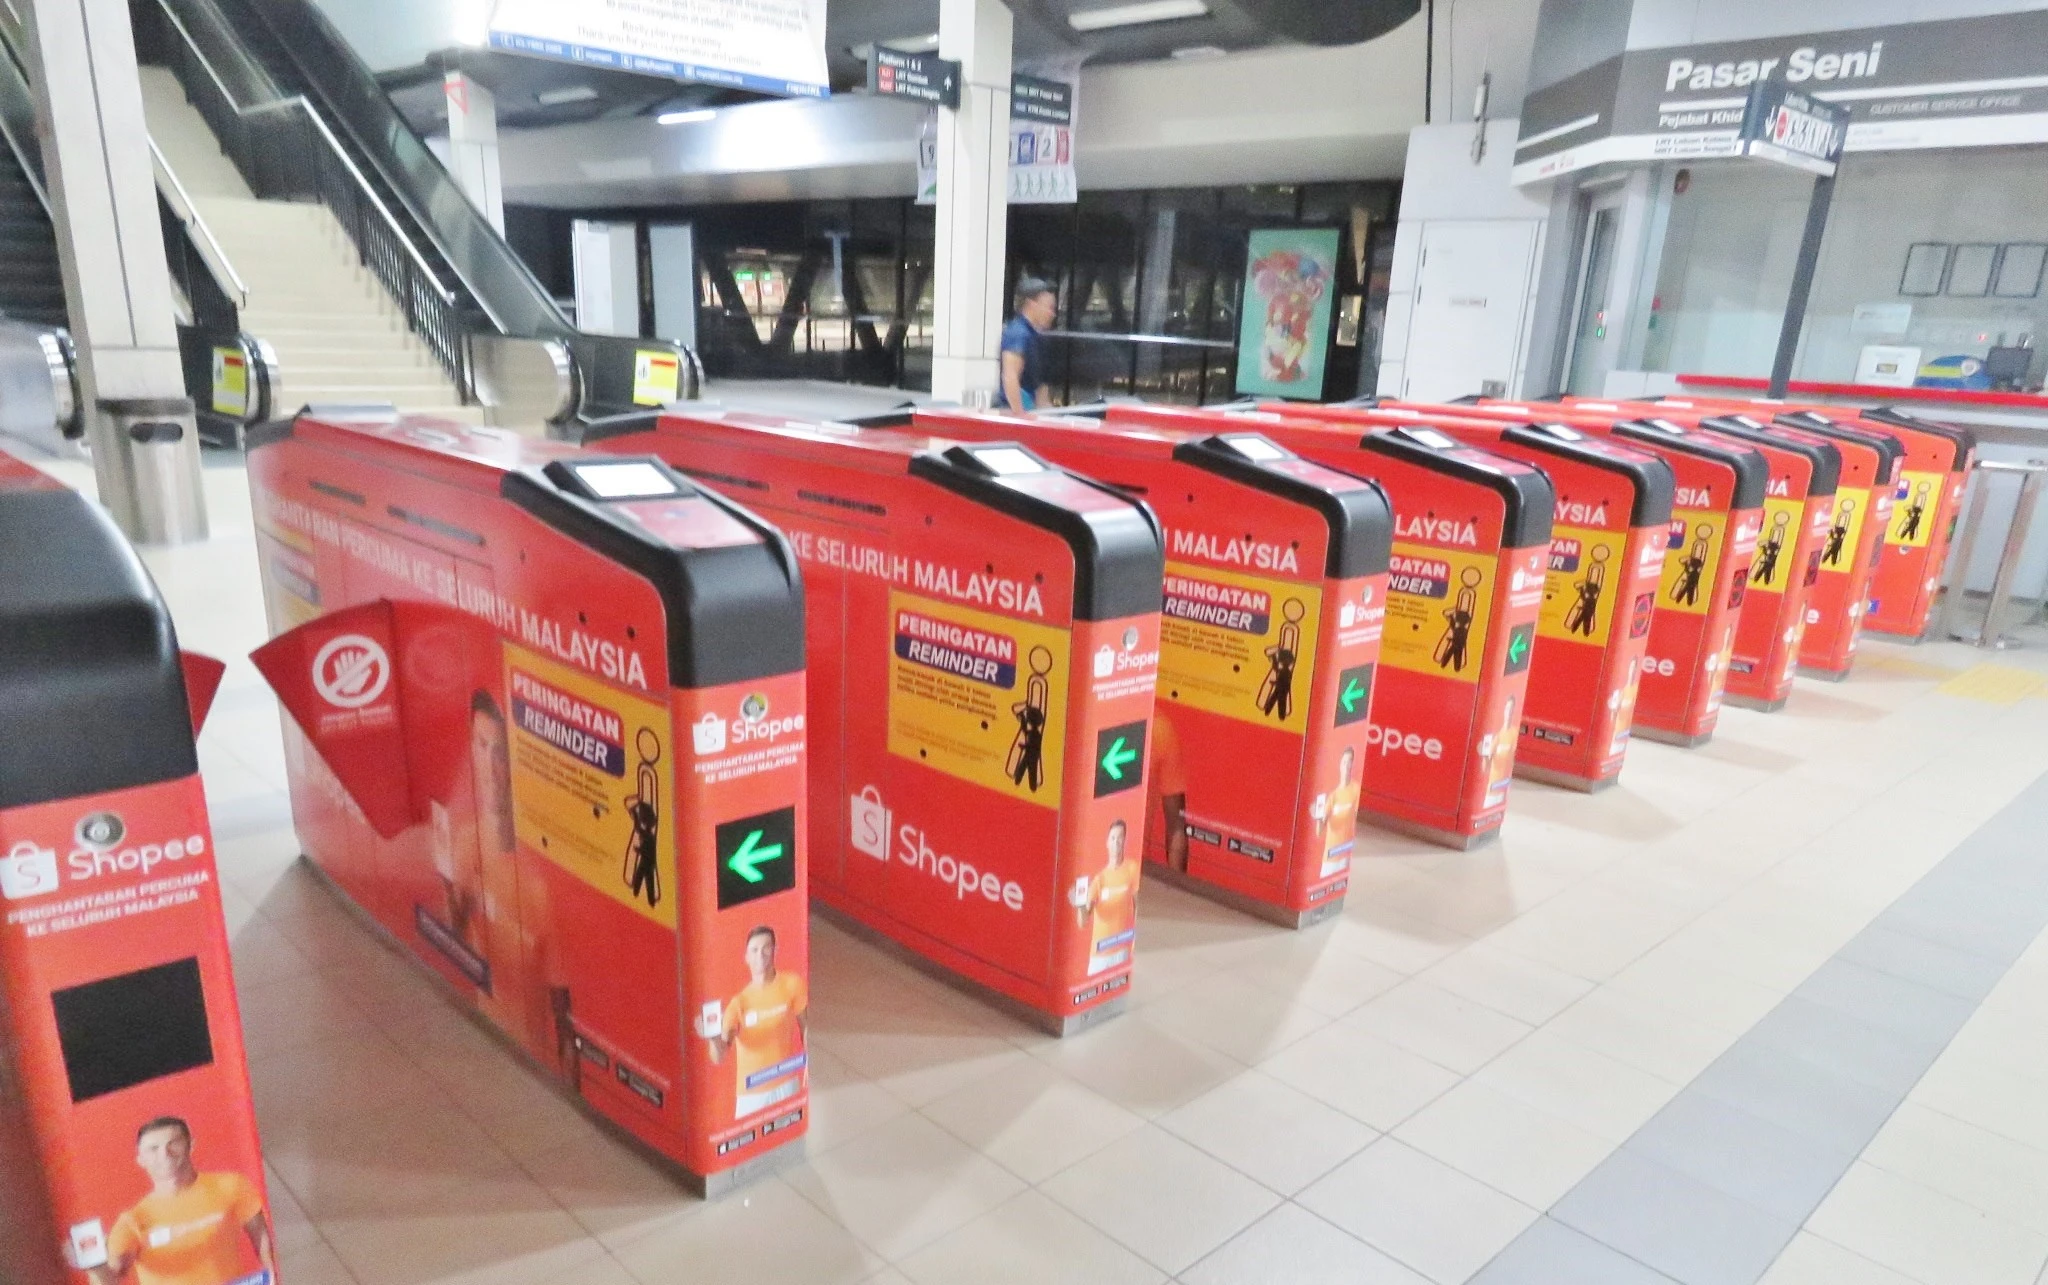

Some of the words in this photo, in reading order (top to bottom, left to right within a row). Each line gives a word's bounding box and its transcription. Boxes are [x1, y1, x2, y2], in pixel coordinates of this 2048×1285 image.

[1665, 56, 1780, 93] Pasar
[1785, 41, 1884, 83] Seni
[1659, 110, 1710, 130] Pejabat
[817, 535, 909, 586] SELURUH
[914, 558, 1045, 617] MALAYSIA
[1173, 528, 1299, 574] MALAYSIA
[898, 612, 1013, 662] PERINGATAN
[1165, 595, 1253, 631] REMINDER
[520, 606, 648, 692] MALAYSIA
[908, 639, 999, 683] REMINDER
[512, 671, 621, 743] PERINGATAN
[730, 713, 805, 745] Shopee
[524, 704, 609, 769] REMINDER
[68, 833, 206, 881] Shopee
[899, 823, 1024, 912] Shopee
[7, 886, 138, 926] PENGHANTARAN
[139, 868, 210, 898] PERCUMA
[26, 919, 49, 939] KE
[50, 905, 122, 934] SELURUH
[124, 888, 200, 916] MALAYSIA
